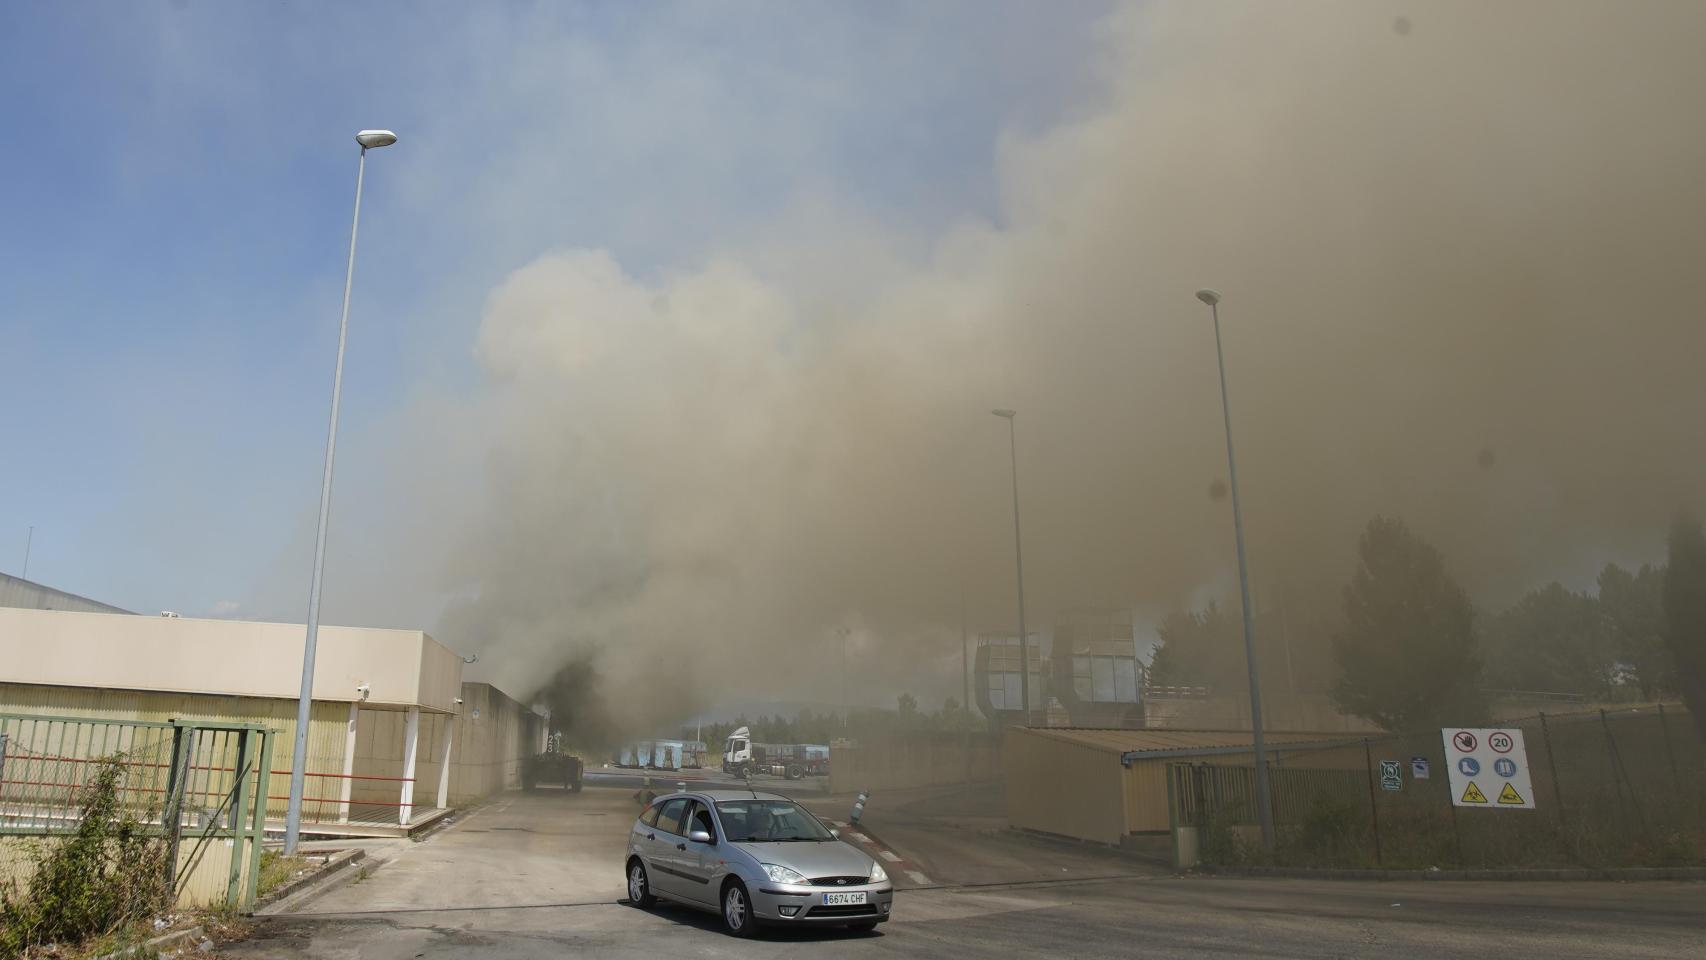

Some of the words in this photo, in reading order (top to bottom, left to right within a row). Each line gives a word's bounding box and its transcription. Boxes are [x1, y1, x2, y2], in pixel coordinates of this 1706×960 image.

[1494, 738, 1508, 747] 20
[829, 894, 848, 904] 6674
[851, 893, 864, 903] CHF
